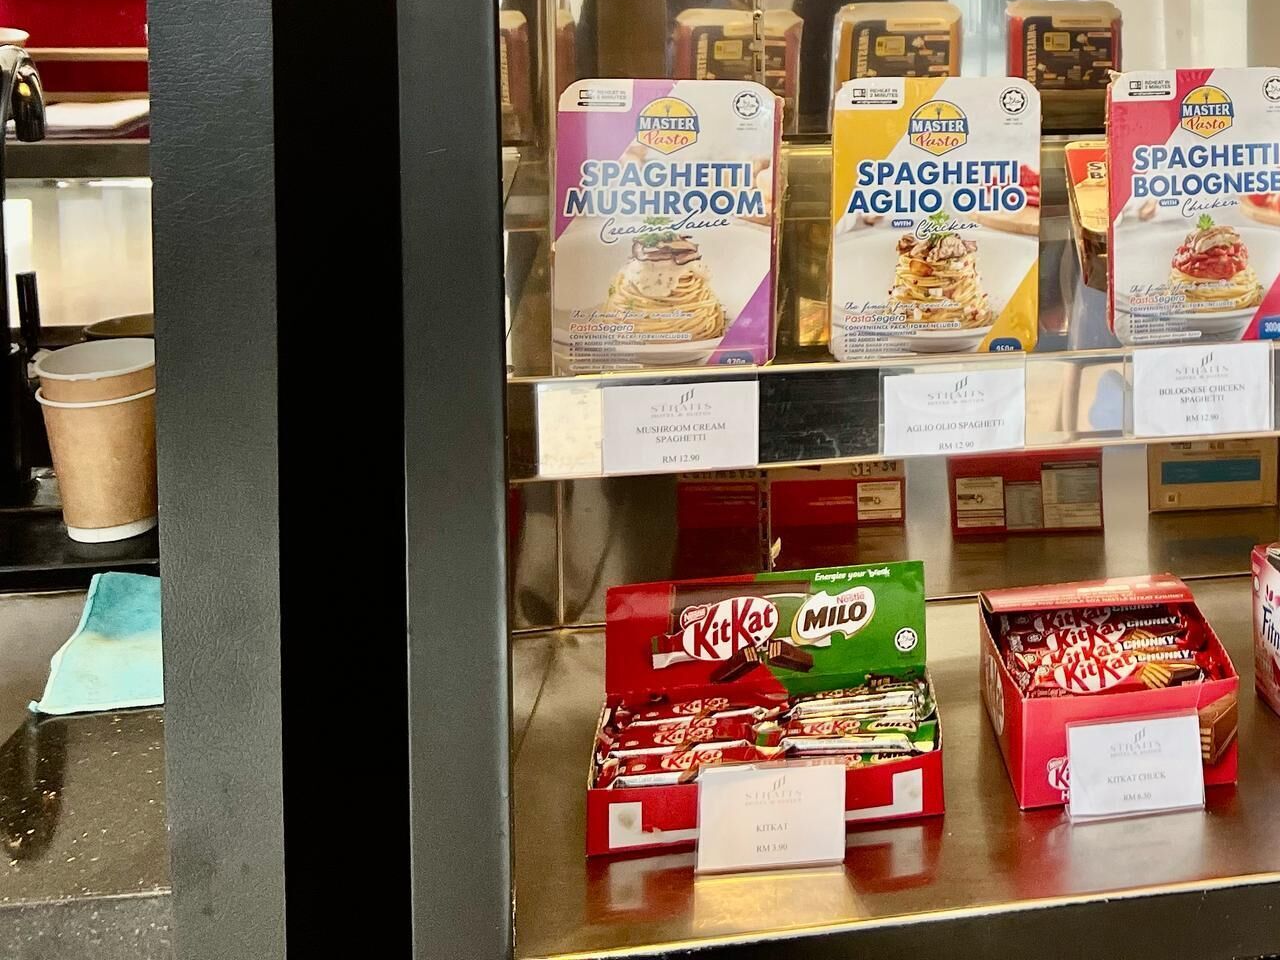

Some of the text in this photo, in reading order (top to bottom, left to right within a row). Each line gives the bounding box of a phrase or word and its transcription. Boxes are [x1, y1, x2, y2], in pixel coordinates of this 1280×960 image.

[1182, 104, 1230, 117] MASTER
[639, 117, 695, 130] MASTER
[912, 120, 965, 133] MASTER
[1134, 143, 1280, 171] SPAGHETTI
[582, 161, 751, 187] SPAGHETTI
[858, 160, 1018, 186] SPAGHETTI
[566, 190, 764, 215] MUSHROOM
[848, 187, 1025, 214] AGLIO OLIO
[1181, 198, 1240, 218] Chicken
[600, 210, 731, 244] Cream Sauce
[915, 219, 980, 239] Chicken
[1129, 294, 1185, 305] PastaSegera
[845, 314, 906, 323] PastaSegera
[570, 323, 634, 333] PastaSegera
[1159, 385, 1208, 396] BOLOGNESE
[1180, 394, 1224, 404] SPAGHETTI
[635, 422, 726, 434] MUSHROOM CREAM
[906, 419, 1004, 433] AGLIO OLIO SPAGHETTI
[655, 433, 707, 443] SPAGHETTI
[938, 441, 974, 450] RM 12.90
[662, 455, 677, 464] RM
[679, 454, 700, 463] 12.90
[847, 571, 867, 581] your
[803, 601, 868, 632] MILO
[1126, 616, 1178, 628] CHUNKY
[693, 597, 775, 659] KitKat
[1123, 635, 1175, 650] CHUNKY
[1063, 649, 1190, 691] KitKat CHUNKY
[1107, 774, 1137, 785] KITKAT
[756, 822, 789, 832] KITKAT
[756, 843, 788, 853] RM 3.90
